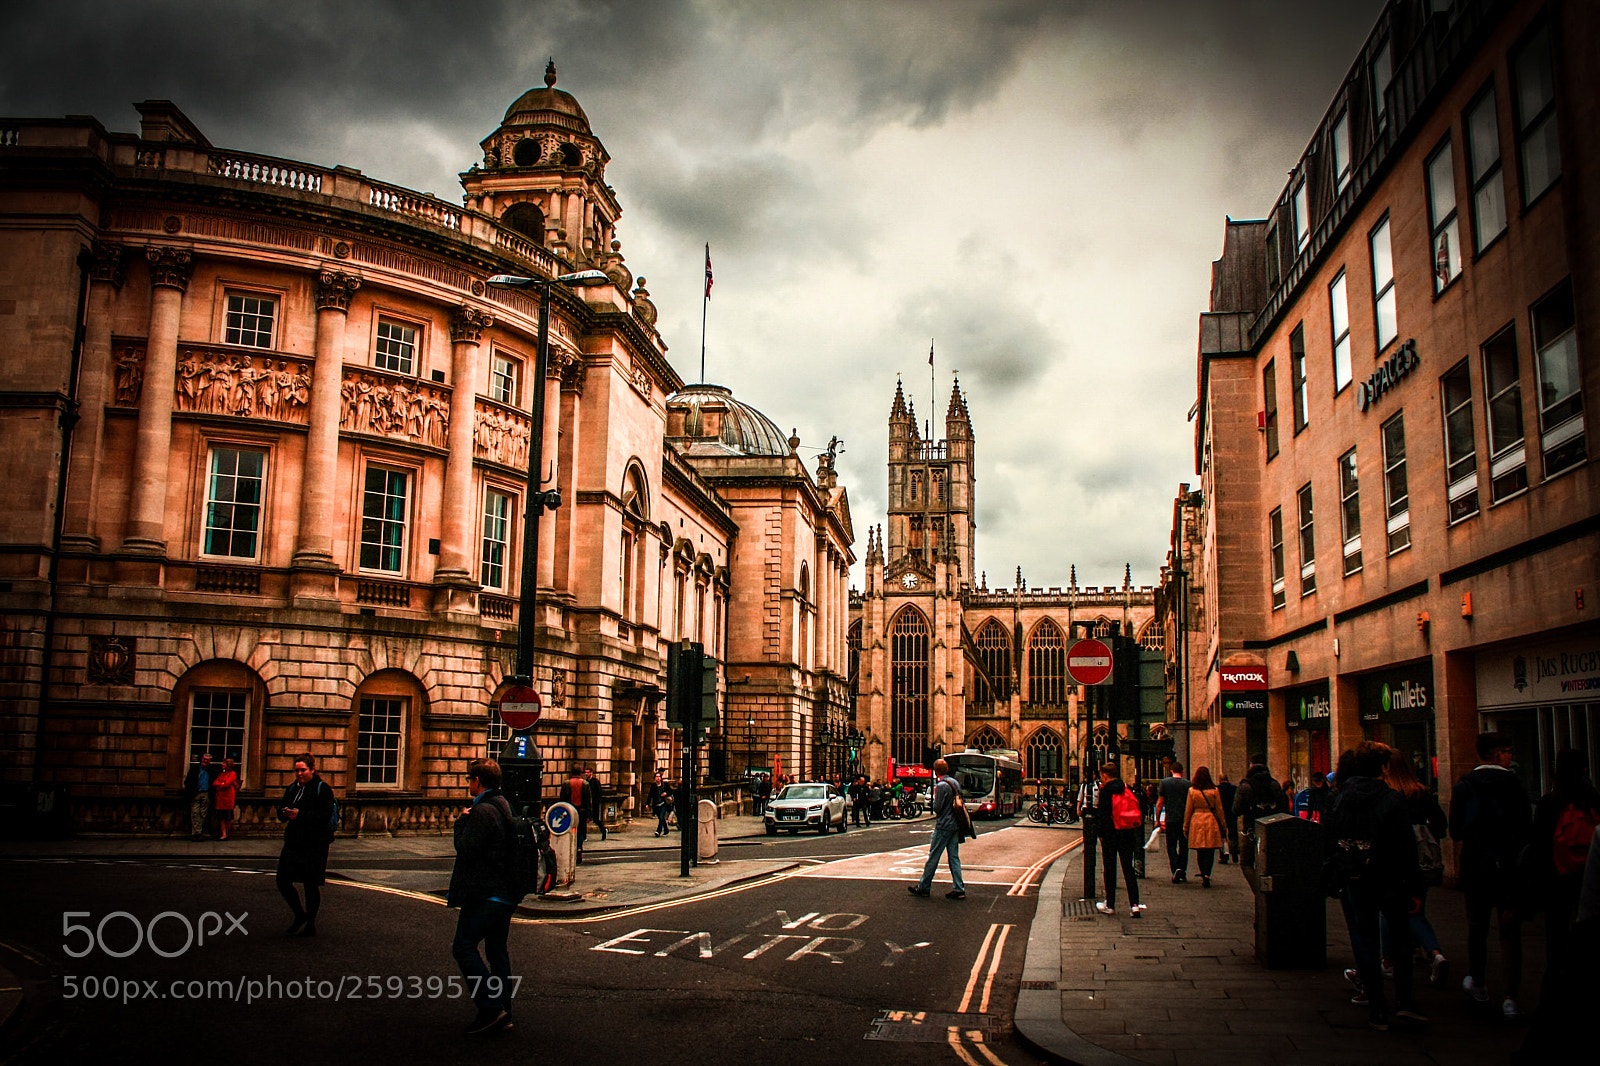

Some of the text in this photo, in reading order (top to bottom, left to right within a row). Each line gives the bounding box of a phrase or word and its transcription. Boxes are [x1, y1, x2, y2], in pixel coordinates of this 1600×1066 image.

[1235, 700, 1264, 709] millets
[1307, 695, 1330, 719] millets
[1392, 680, 1427, 710] millets
[745, 910, 870, 931] NO
[588, 928, 934, 967] ENTRY
